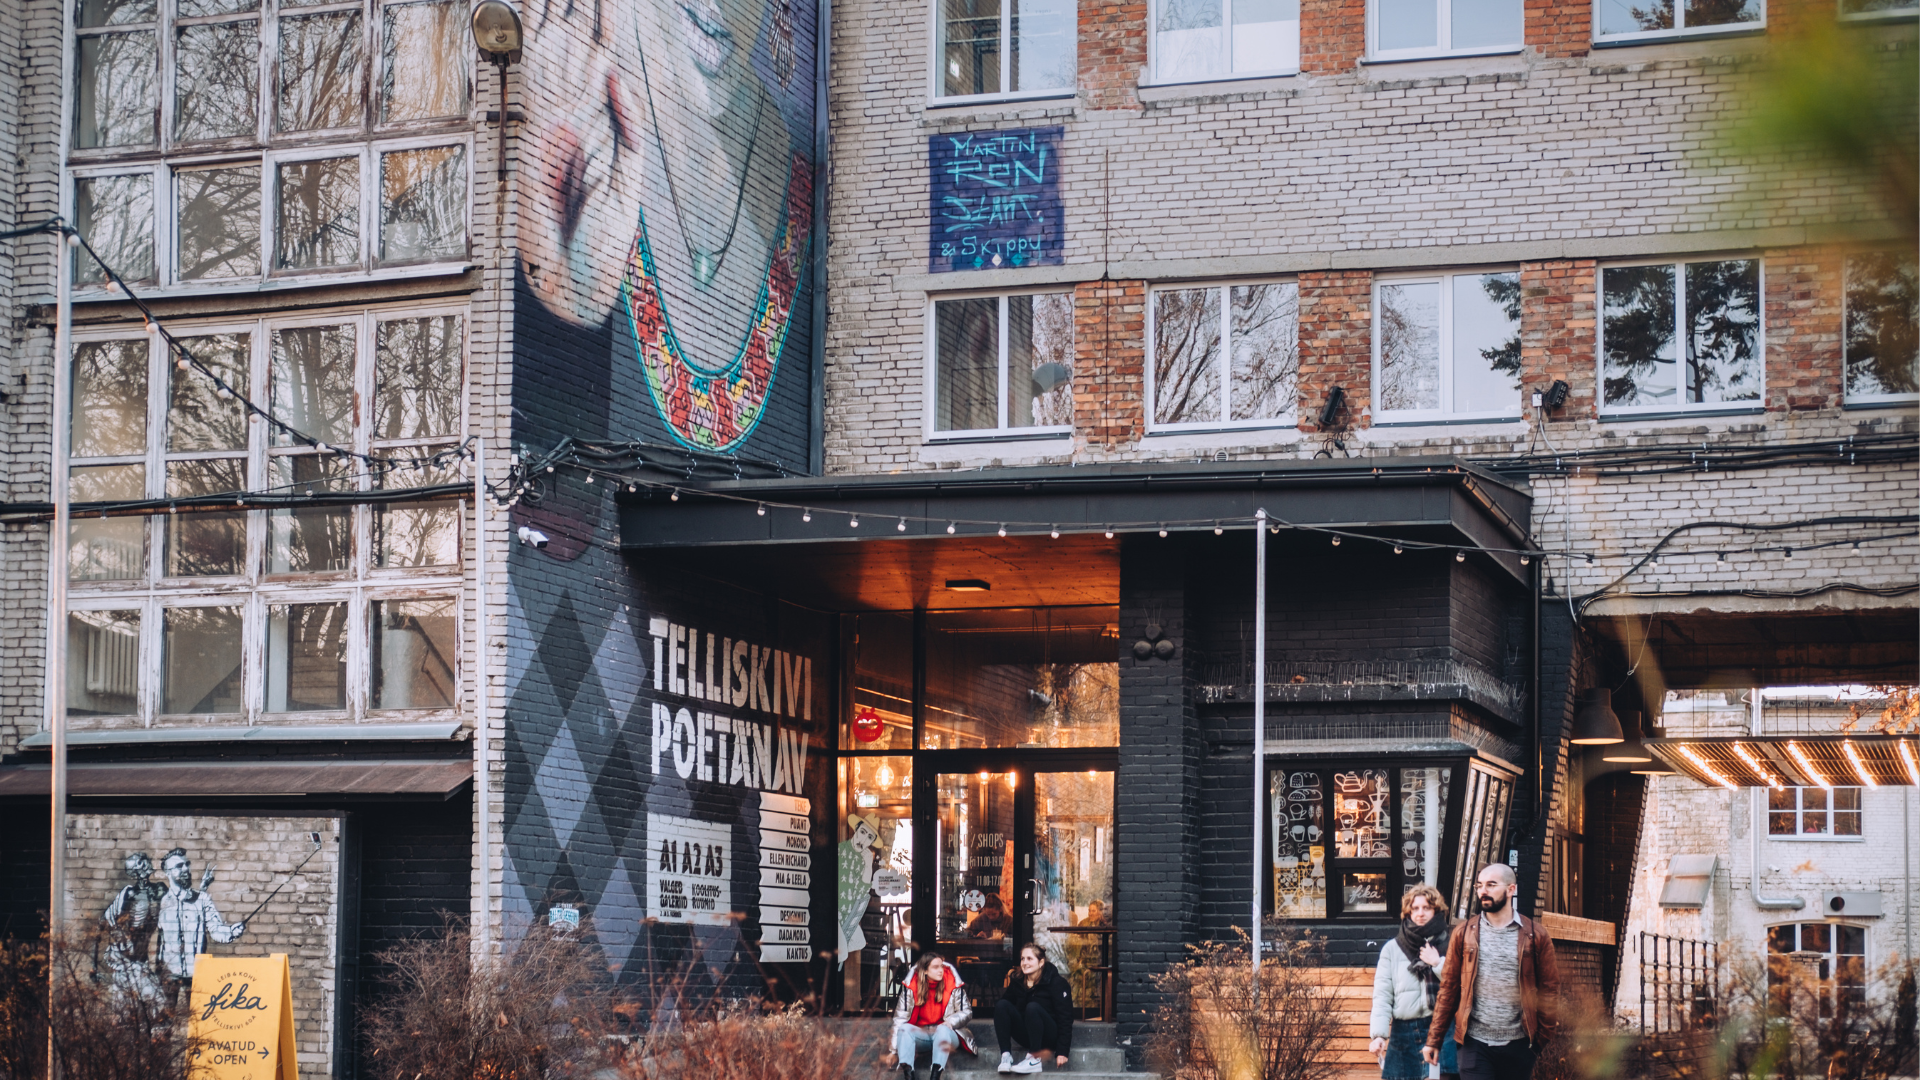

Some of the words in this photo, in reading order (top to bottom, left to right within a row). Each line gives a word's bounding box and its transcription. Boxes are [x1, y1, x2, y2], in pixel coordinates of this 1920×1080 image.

[941, 243, 955, 257] &
[648, 618, 812, 721] TELLISKIVI
[977, 833, 1004, 848] SHOPS
[660, 839, 677, 873] A1
[682, 841, 702, 875] A2
[704, 844, 723, 877] A3
[769, 852, 785, 866] ELLEN
[785, 853, 808, 868] RICHARD
[775, 872, 785, 884] MIA
[786, 873, 791, 885] &
[791, 873, 807, 886] LEELA
[1348, 884, 1381, 904] fika
[786, 947, 808, 960] KAKTUS
[216, 972, 231, 983] LEIB
[239, 972, 257, 983] KOHV
[201, 983, 268, 1021] fika
[212, 1015, 244, 1030] TELLISKIVI
[207, 1041, 256, 1051] AVATUD
[213, 1054, 247, 1065] OPEN
